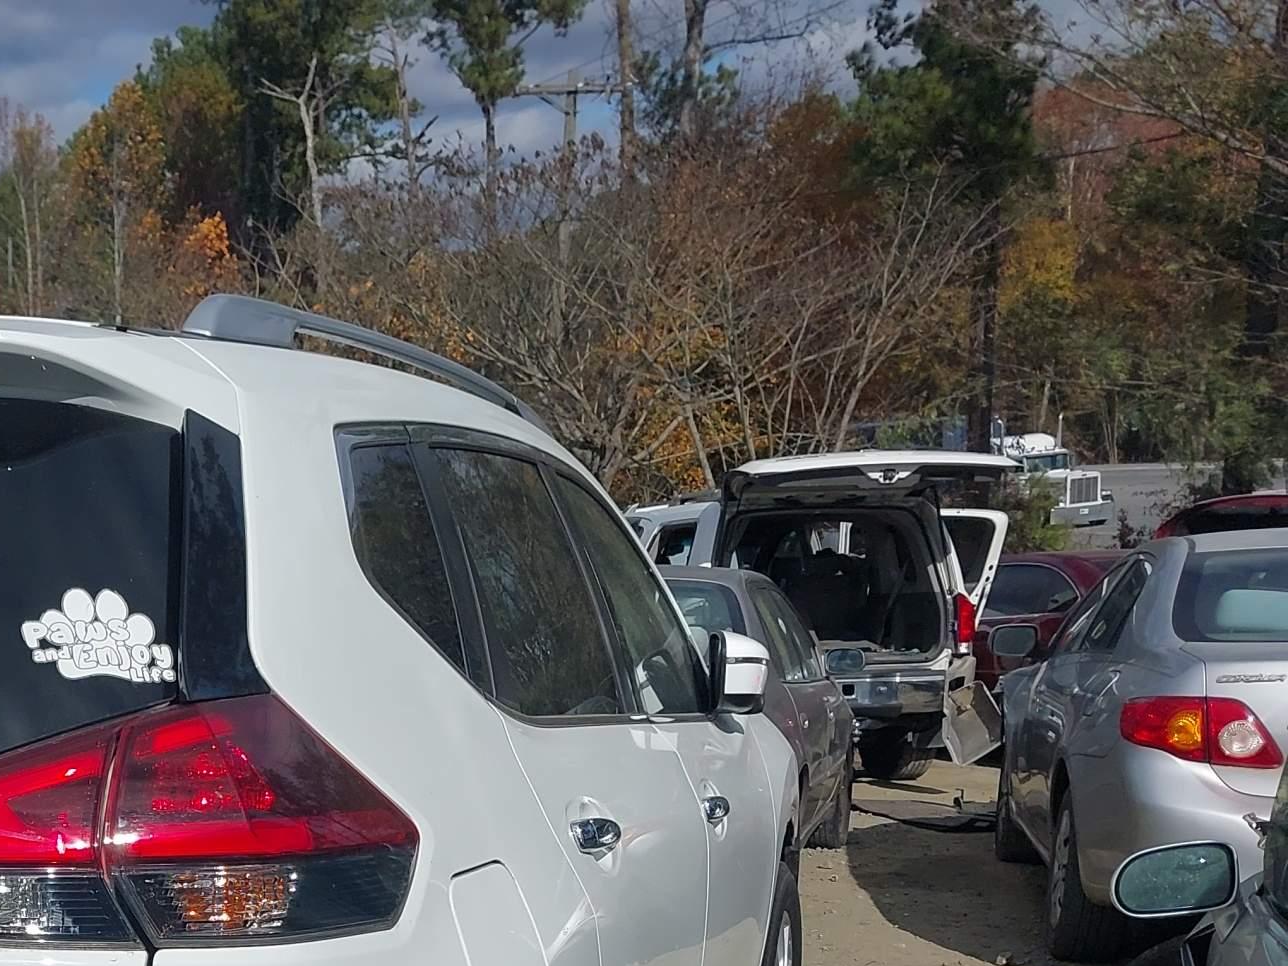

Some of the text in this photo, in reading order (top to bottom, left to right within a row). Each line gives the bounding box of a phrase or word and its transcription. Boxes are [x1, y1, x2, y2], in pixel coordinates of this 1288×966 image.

[21, 618, 130, 649] Paws
[32, 641, 173, 671] and Enjoy
[130, 668, 177, 683] Life
